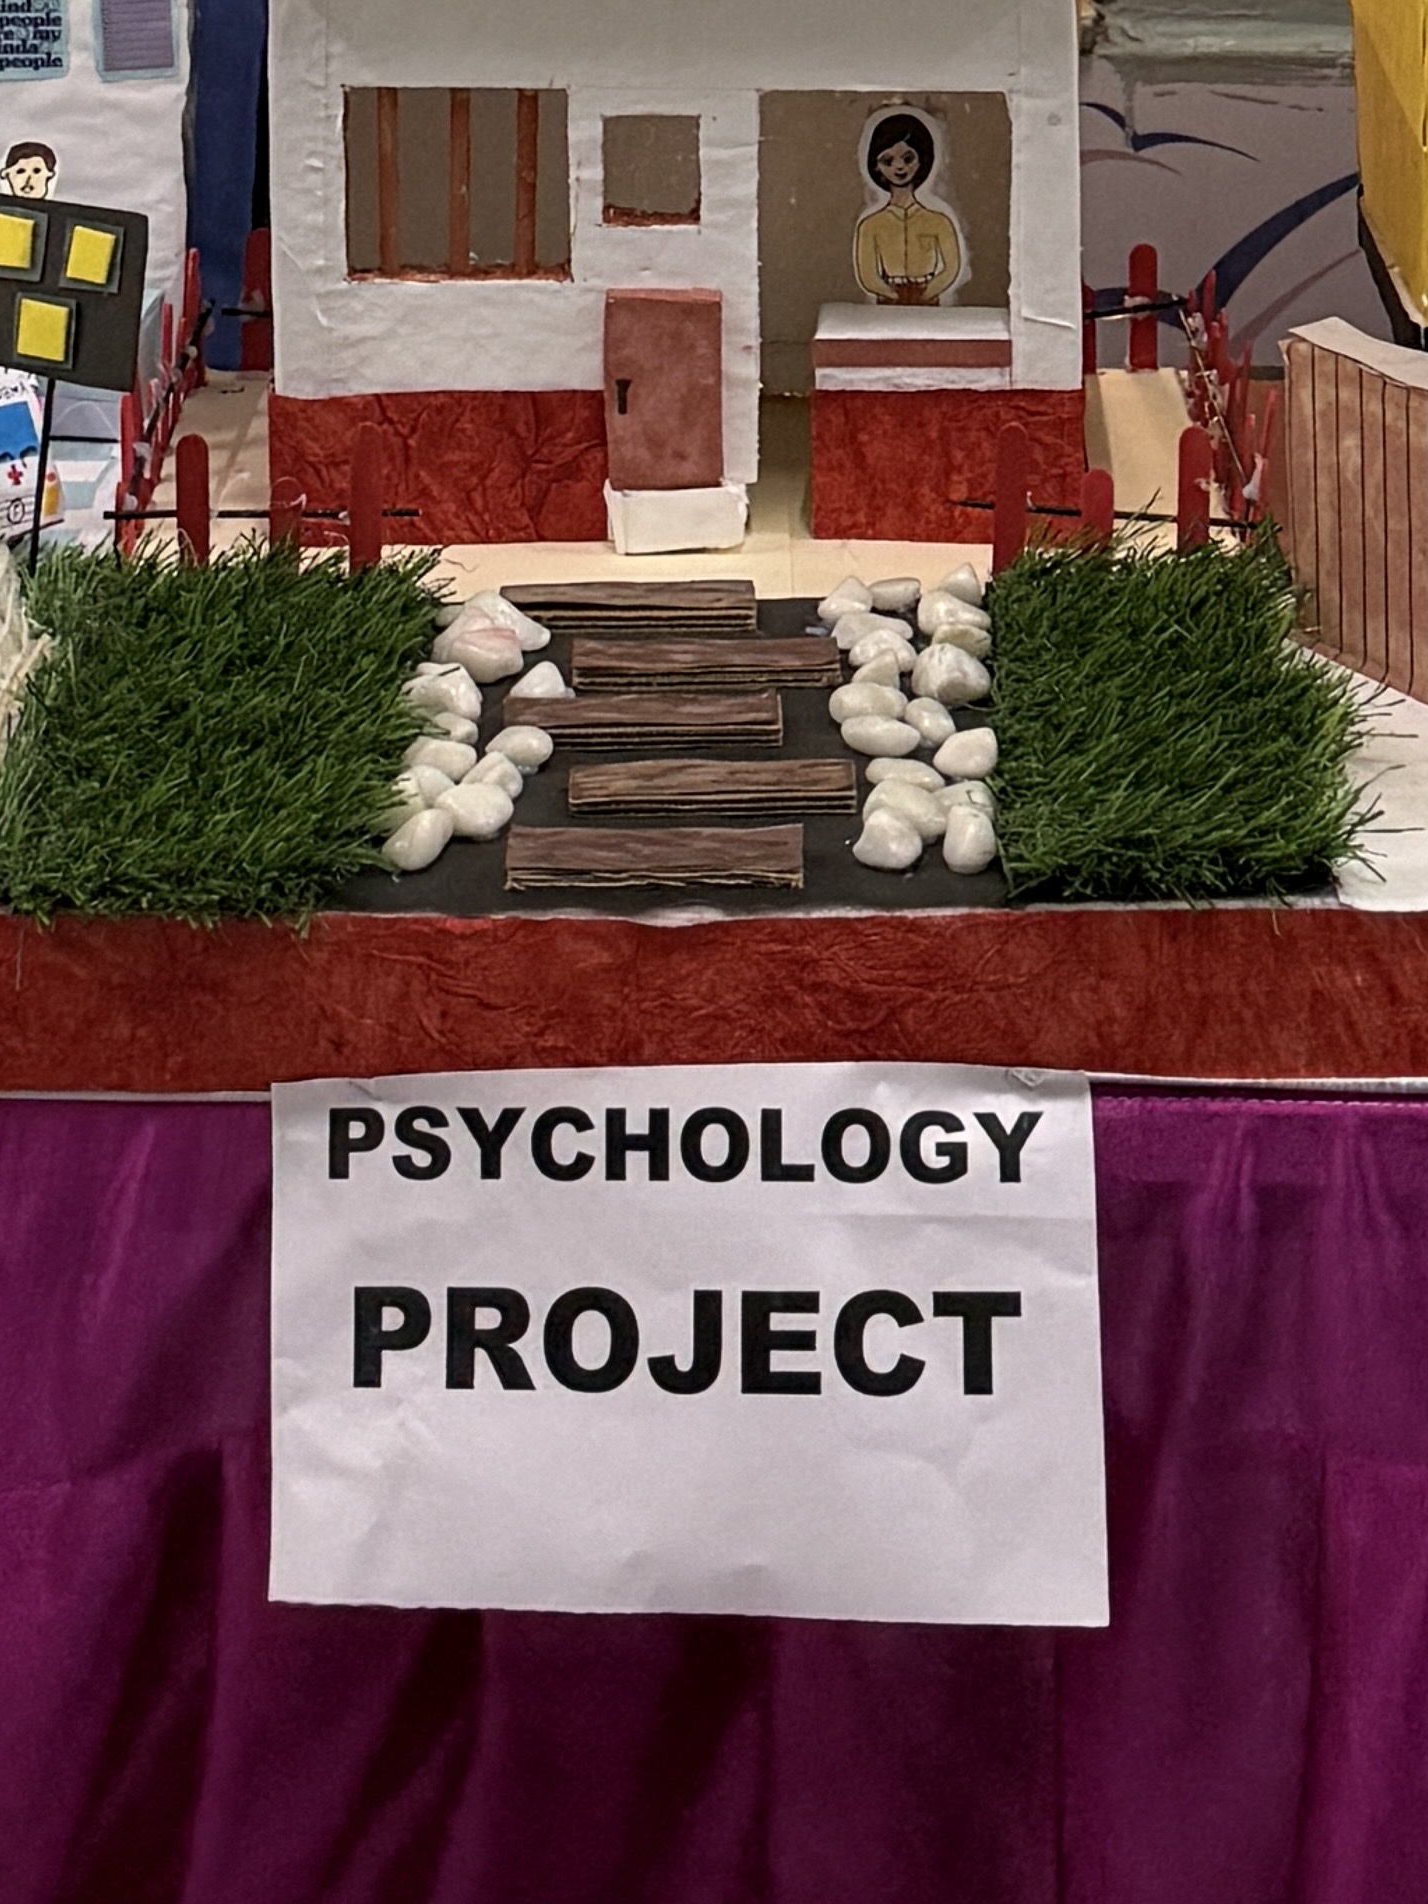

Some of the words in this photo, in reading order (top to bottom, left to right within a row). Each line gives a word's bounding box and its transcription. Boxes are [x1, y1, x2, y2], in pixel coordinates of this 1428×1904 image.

[33, 29, 62, 42] my
[328, 1104, 1043, 1185] PSYCHOLOGY
[351, 1285, 1022, 1397] PROJECT
